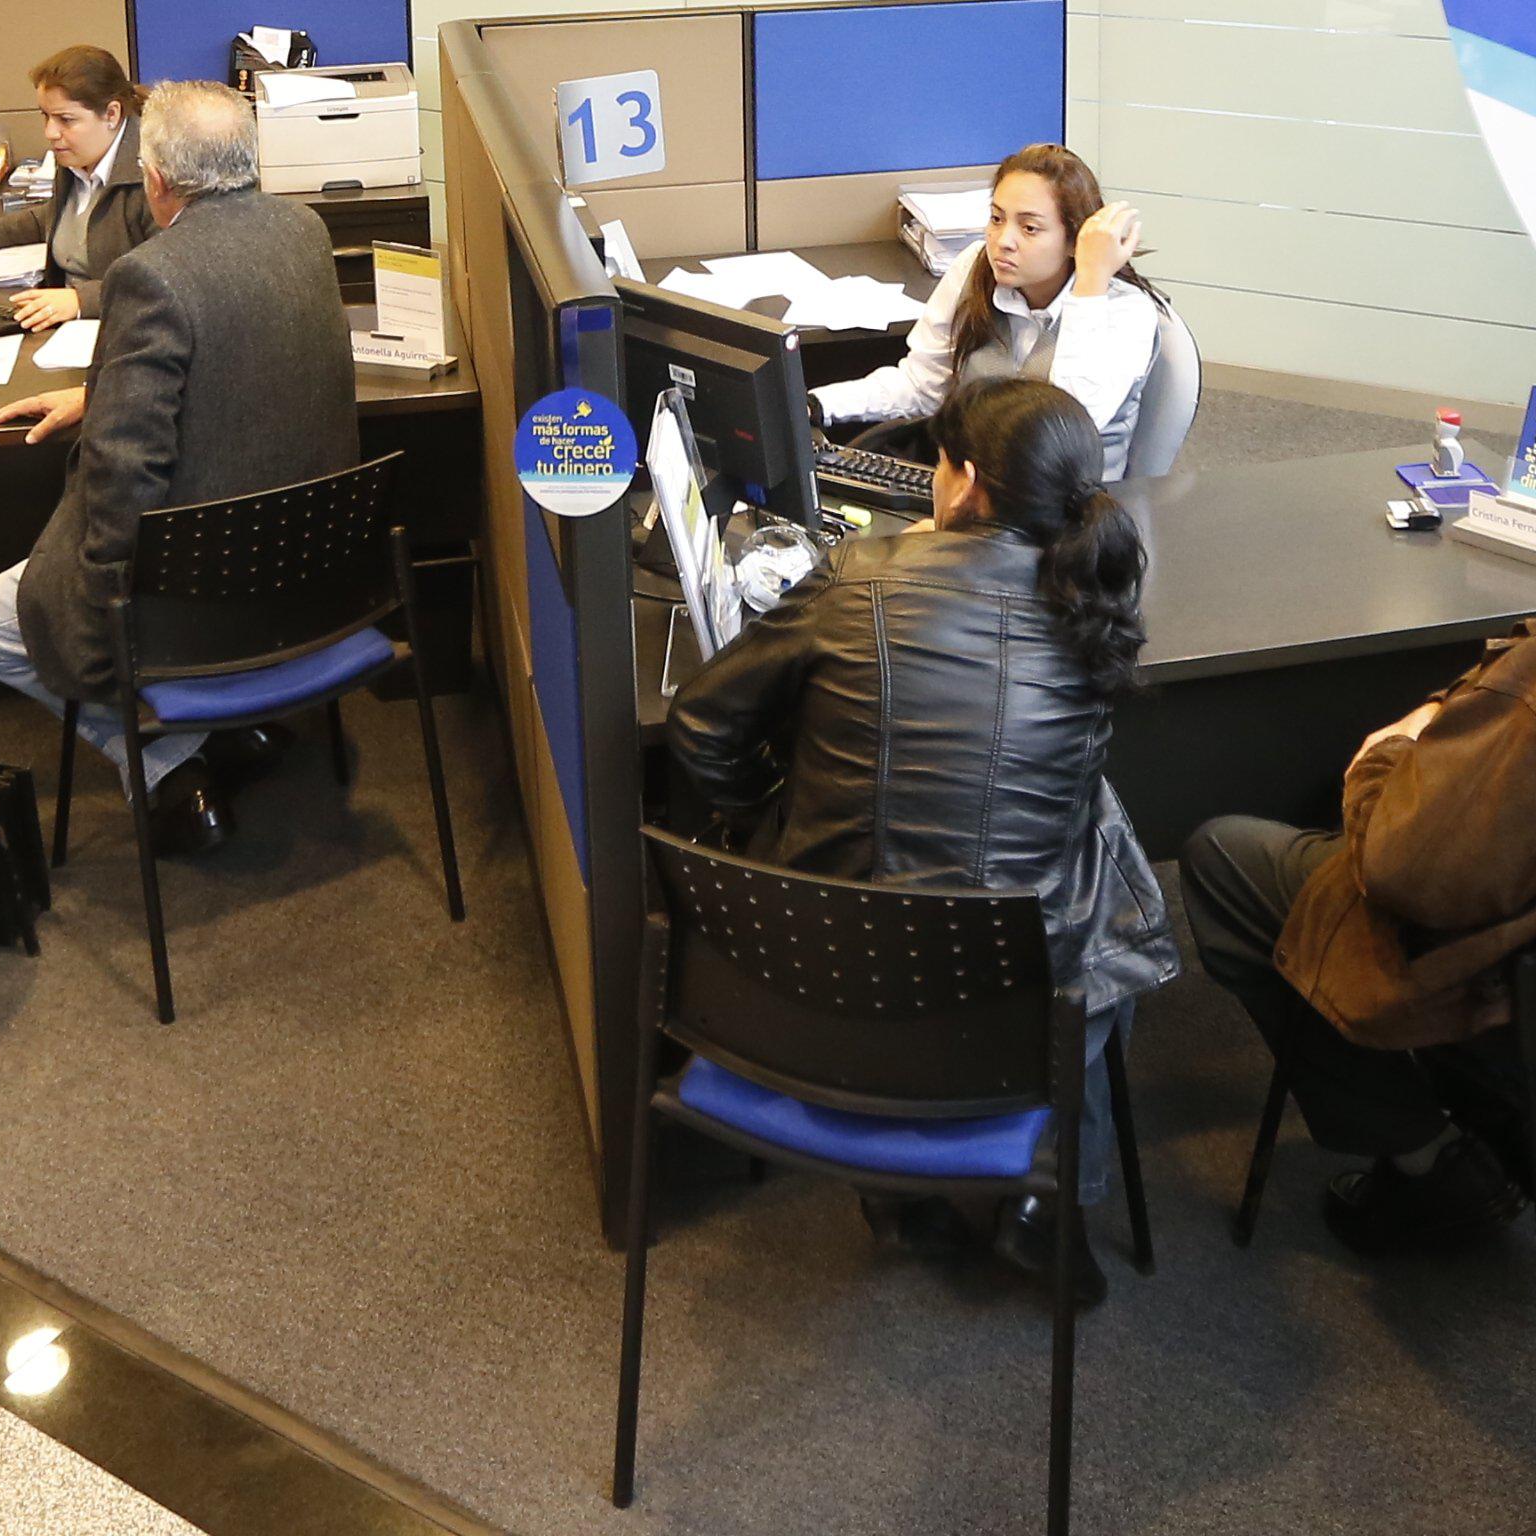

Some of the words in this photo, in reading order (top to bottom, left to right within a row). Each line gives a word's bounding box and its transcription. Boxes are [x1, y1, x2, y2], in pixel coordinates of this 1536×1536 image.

[568, 90, 657, 164] 13
[532, 414, 563, 424] existen
[533, 421, 560, 436] más
[563, 423, 609, 436] formas
[539, 437, 551, 446] de
[552, 437, 576, 446] hacer
[553, 444, 615, 459] crecer
[536, 460, 554, 475] tu
[558, 459, 614, 475] dinero
[1472, 507, 1510, 529] Cristina
